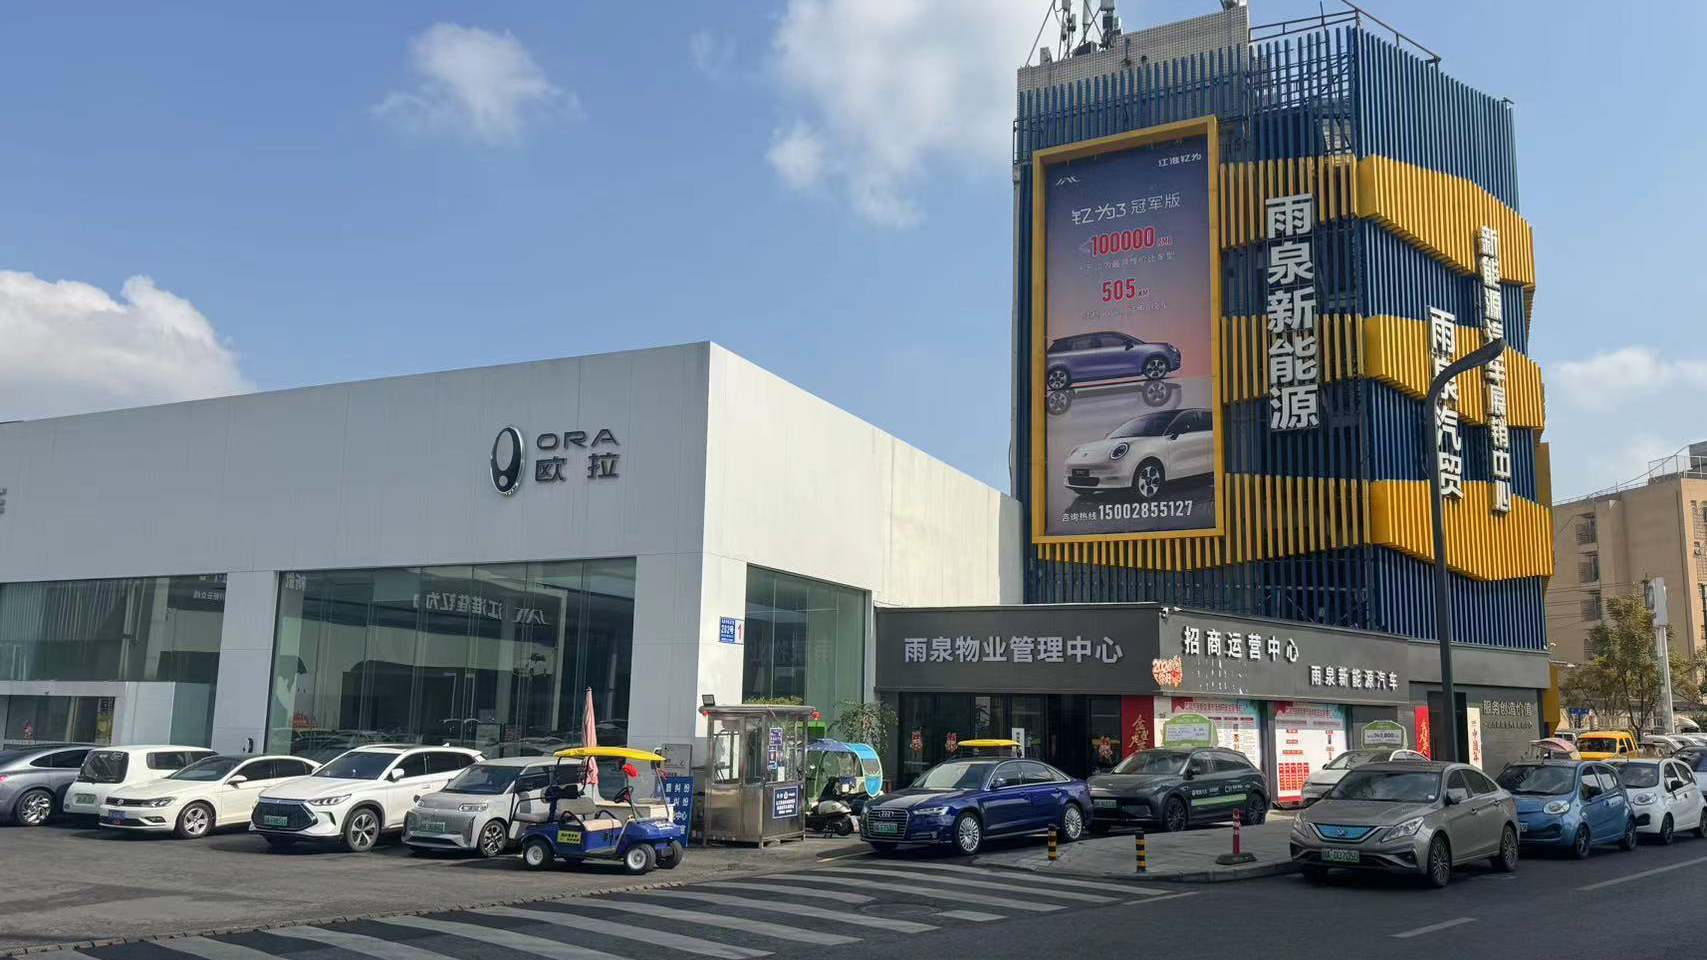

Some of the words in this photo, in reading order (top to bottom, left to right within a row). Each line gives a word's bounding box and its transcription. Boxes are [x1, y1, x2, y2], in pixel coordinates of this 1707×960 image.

[1102, 277, 1136, 302] 505
[1264, 193, 1319, 430] 雨泉新能源
[536, 428, 620, 450] ORA
[535, 452, 620, 483] 欧拉
[1061, 511, 1097, 522] 咨询热线
[1098, 500, 1193, 520] 15002855127
[904, 636, 1123, 664] 雨泉物业管理中心
[1184, 626, 1299, 663] 招商运营中心
[1310, 664, 1398, 691] 雨泉新能源汽车
[1483, 700, 1532, 717] 服务创造价值
